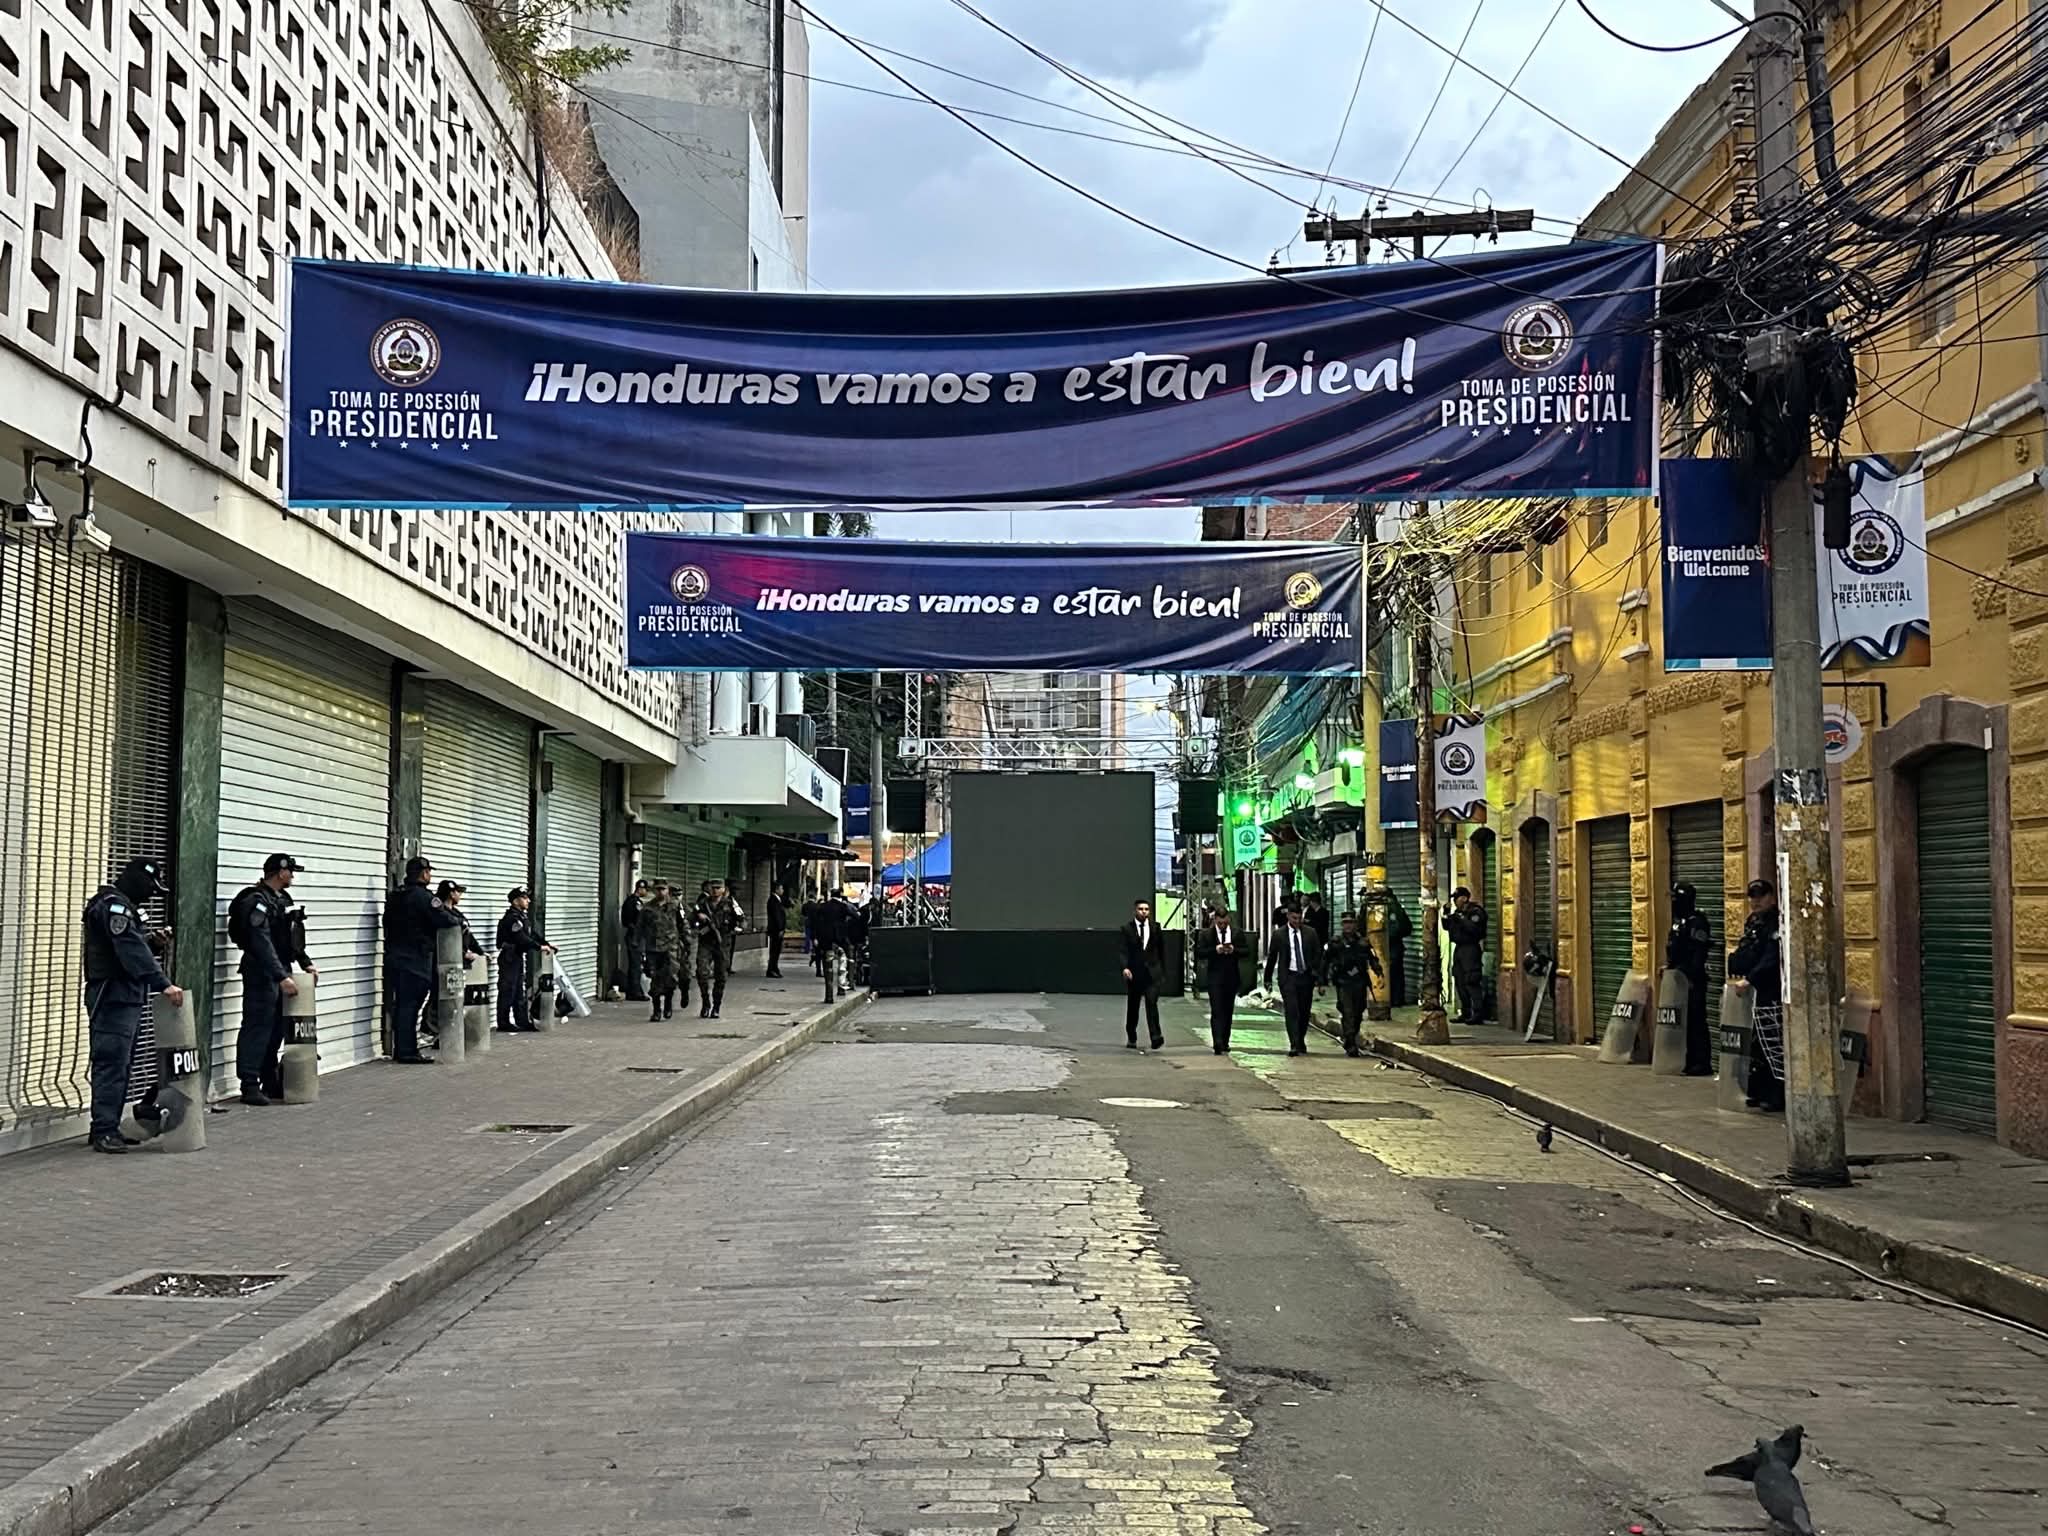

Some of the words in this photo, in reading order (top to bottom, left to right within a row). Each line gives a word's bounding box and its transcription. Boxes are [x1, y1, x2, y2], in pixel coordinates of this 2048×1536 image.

[525, 363, 800, 405] ¡Honduras
[815, 369, 990, 405] vamos
[1004, 371, 1035, 403] a
[1064, 351, 1227, 405] estar
[1249, 337, 1417, 403] bien!
[1461, 379, 1505, 397] TOMA
[1511, 378, 1531, 395] DE
[1536, 371, 1616, 393] POSESIÓN
[330, 391, 372, 408] TOMA
[379, 392, 398, 409] DE
[404, 389, 481, 411] POSESIÓN
[1441, 393, 1632, 427] PRESIDENCIAL
[309, 409, 498, 440] PRESIDENCIAL
[1667, 545, 1765, 562] Bienvenidos
[1683, 562, 1750, 577] Welcome
[756, 589, 911, 612] ¡Honduras
[919, 594, 1014, 613] vamos
[1021, 595, 1040, 613] a
[1052, 587, 1143, 617] estar
[1153, 584, 1241, 619] bien!
[1832, 589, 1913, 604] PRESIDENCIAL
[649, 605, 673, 616] TOMA
[677, 605, 687, 616] DE
[690, 603, 732, 617] POSESIÓN
[1263, 611, 1286, 622] TOMA
[1289, 612, 1299, 622] DE
[1301, 610, 1342, 623] POSESIÓN
[638, 615, 743, 633] PRESIDENCIAL
[1253, 622, 1352, 639] PRESIDENCIAL
